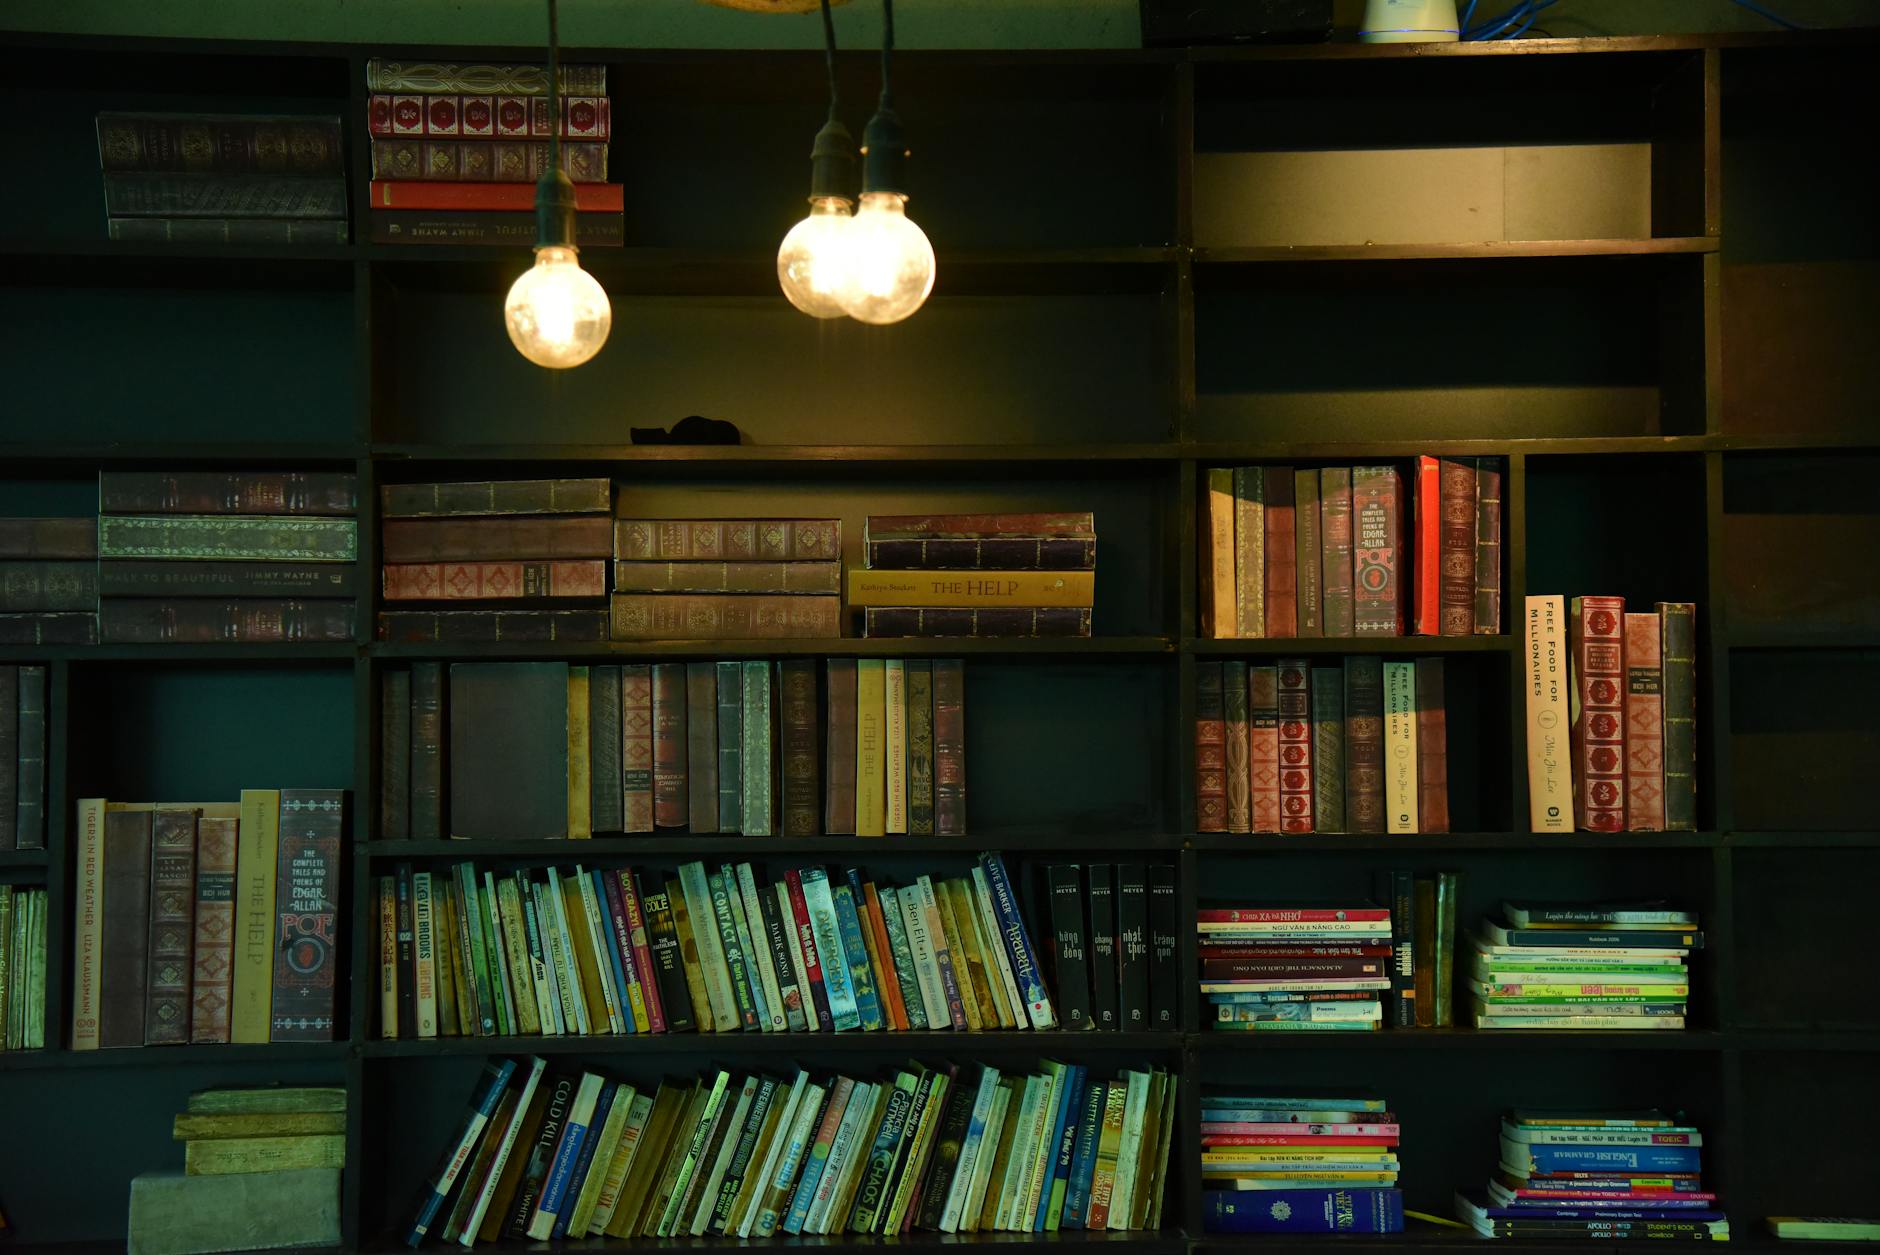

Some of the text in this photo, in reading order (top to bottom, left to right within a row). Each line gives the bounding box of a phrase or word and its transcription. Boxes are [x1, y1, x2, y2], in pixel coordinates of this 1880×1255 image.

[1363, 530, 1387, 538] EDGAR
[245, 571, 320, 581] JIMMY WAYNE
[1355, 548, 1393, 571] POE
[144, 573, 157, 583] TO
[164, 573, 235, 584] BEAUTIFUL
[931, 581, 962, 594] THE
[966, 580, 1018, 596] HELP
[1530, 609, 1542, 697] MILLIONAIRES
[1546, 602, 1558, 702] FREE FOOD FOR
[1390, 671, 1398, 736] MILLIONAIRES
[864, 713, 876, 777] THE HELP
[894, 745, 902, 779] WEATHER
[292, 859, 323, 867] COMPLETE
[292, 868, 326, 876] TALES AND
[292, 878, 323, 886] POEMS OF
[292, 887, 327, 898] EDGAR
[620, 871, 632, 892] BOY
[994, 881, 1013, 914] BARKER
[82, 807, 97, 1014] TIGERS IN RED WEATHER LIZA KLAUSSMANN
[247, 874, 266, 966] THE HELP
[290, 900, 322, 911] ALLAN
[624, 892, 640, 926] CRAZY!
[645, 899, 669, 912] COLE
[714, 890, 736, 944] CONTACT
[907, 902, 921, 925] Ben
[1259, 912, 1271, 920] XA
[1280, 910, 1302, 920] NHỚ
[280, 913, 334, 946] POE
[419, 921, 431, 958] BROOKS
[770, 921, 790, 977] DARK SONG
[815, 909, 849, 1002] DIVERGENT
[1157, 948, 1171, 962] non
[750, 1080, 776, 1121] DEFENDER
[880, 1089, 906, 1139] Cornwell
[891, 1100, 910, 1134] Patricia
[1039, 1093, 1047, 1109] DAVE
[1102, 1087, 1118, 1125] STRONG
[1111, 1086, 1128, 1128] TERENCE
[624, 1126, 640, 1145] THE
[1079, 1085, 1102, 1159] MINETTE WALTERS
[513, 1077, 573, 1225] COLD KILL WHITE
[1028, 1142, 1037, 1159] HELP
[1596, 1152, 1638, 1168] ENGLISH
[808, 1161, 821, 1177] THE
[861, 1156, 887, 1205] CHAOS
[1021, 1160, 1033, 1192] YOURSELF
[597, 1190, 613, 1209] SIX
[1091, 1169, 1106, 1205] HOSTAGE
